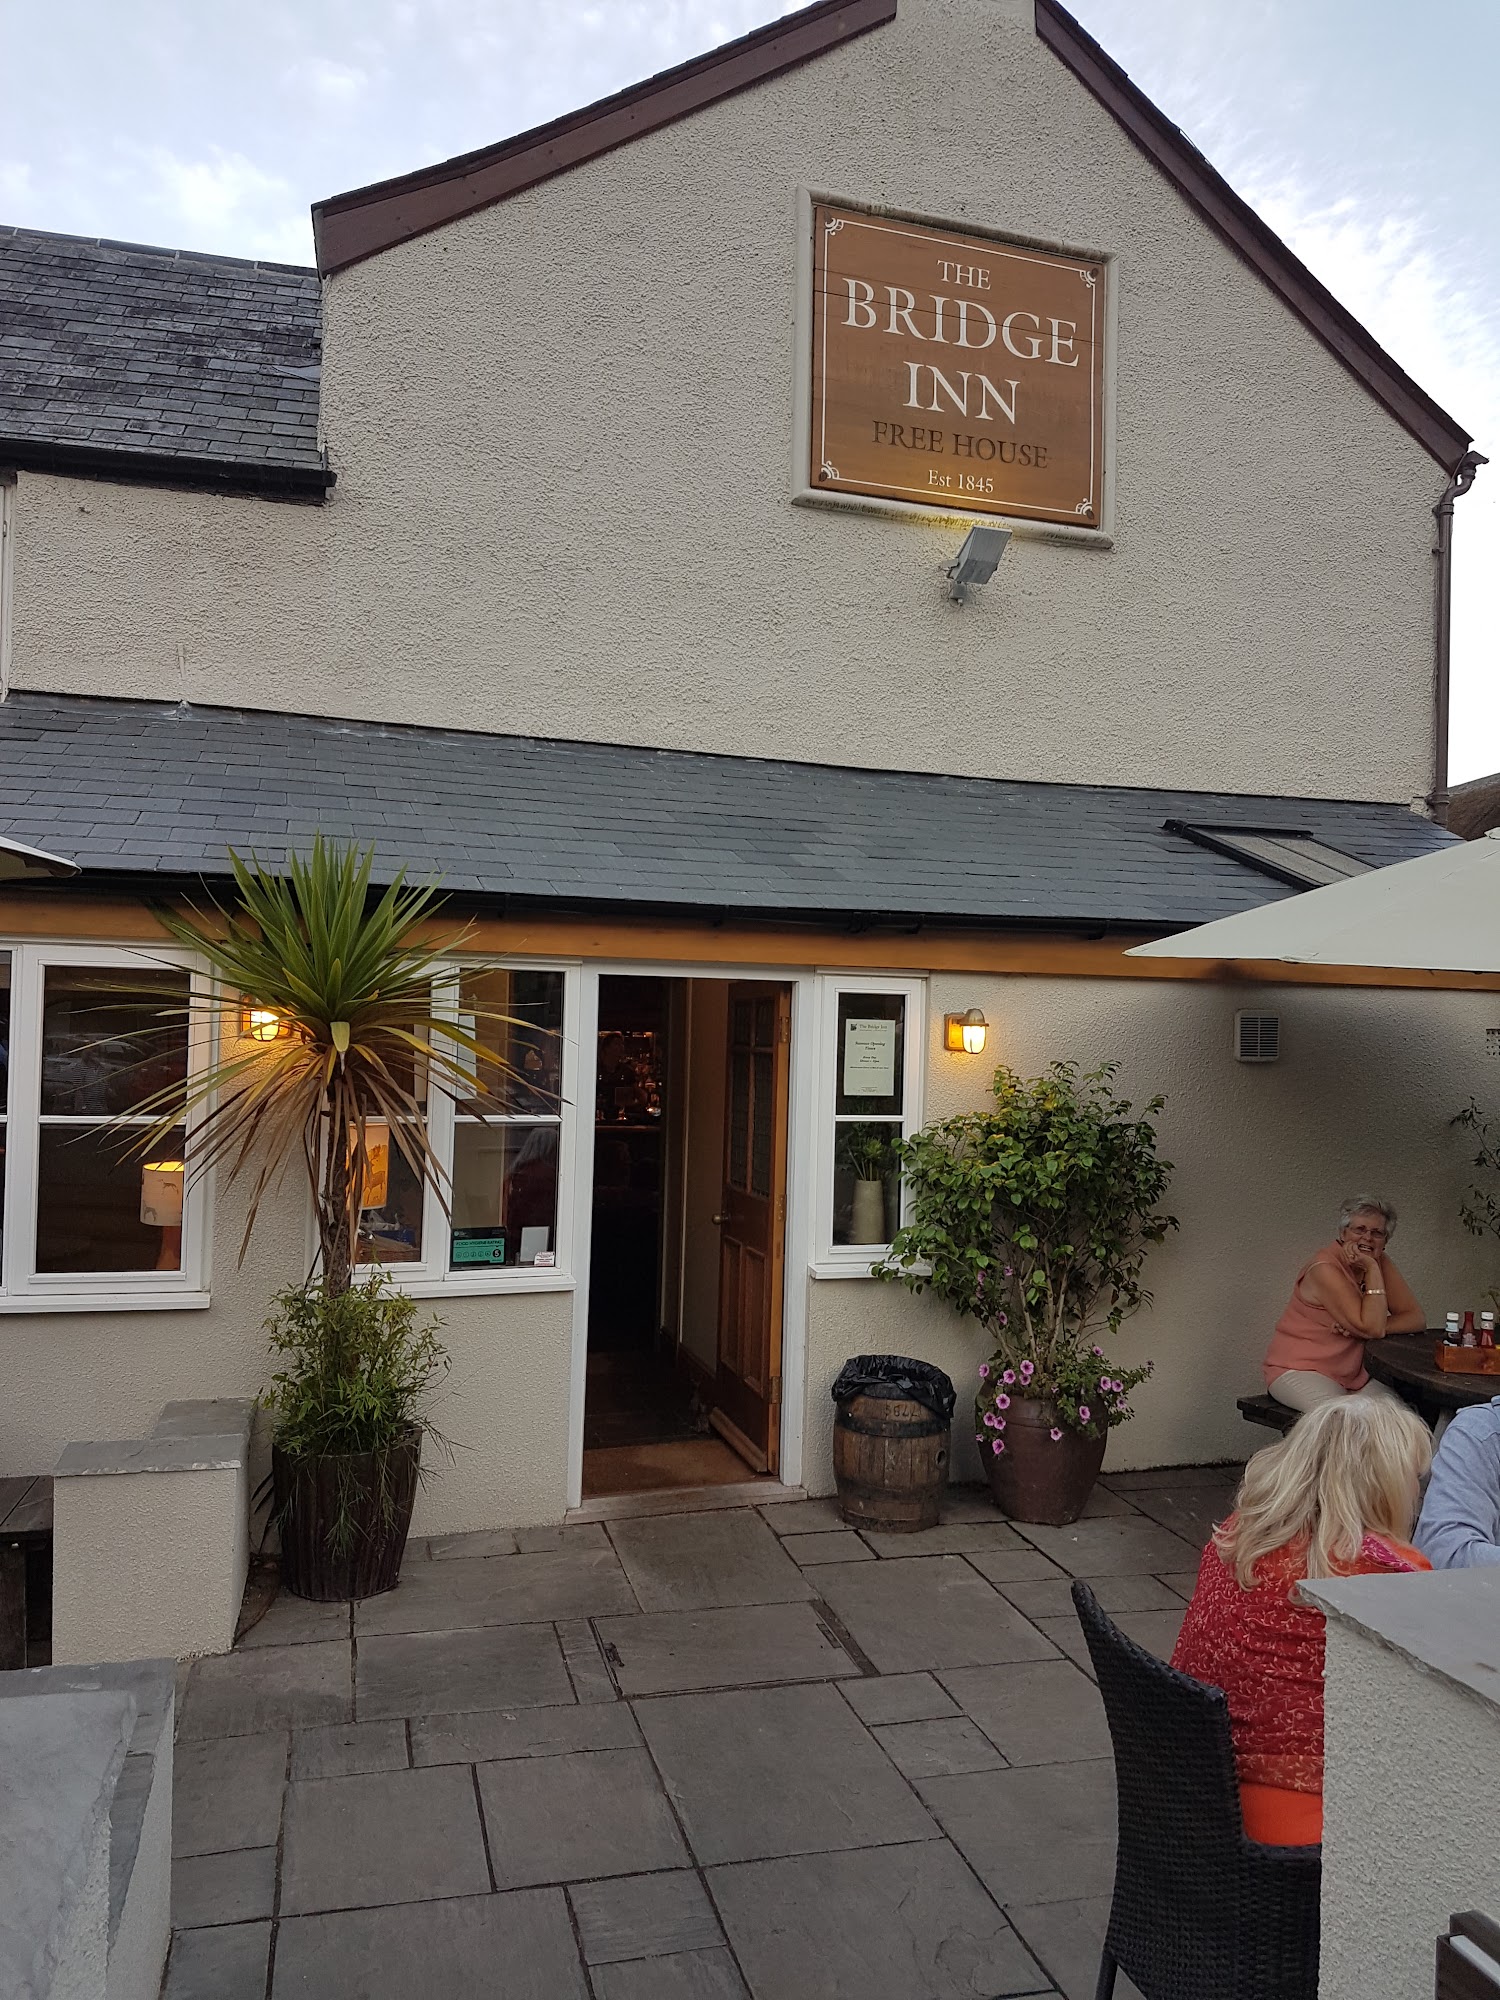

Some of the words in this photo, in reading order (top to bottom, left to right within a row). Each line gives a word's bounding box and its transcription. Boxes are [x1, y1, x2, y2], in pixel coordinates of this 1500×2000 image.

[936, 259, 992, 291] THE
[841, 277, 1080, 368] BRIDGE
[902, 360, 1021, 425] INN
[871, 419, 945, 454] FREE
[951, 433, 1049, 469] HOUSE
[927, 469, 952, 488] Est
[957, 473, 994, 493] 1845
